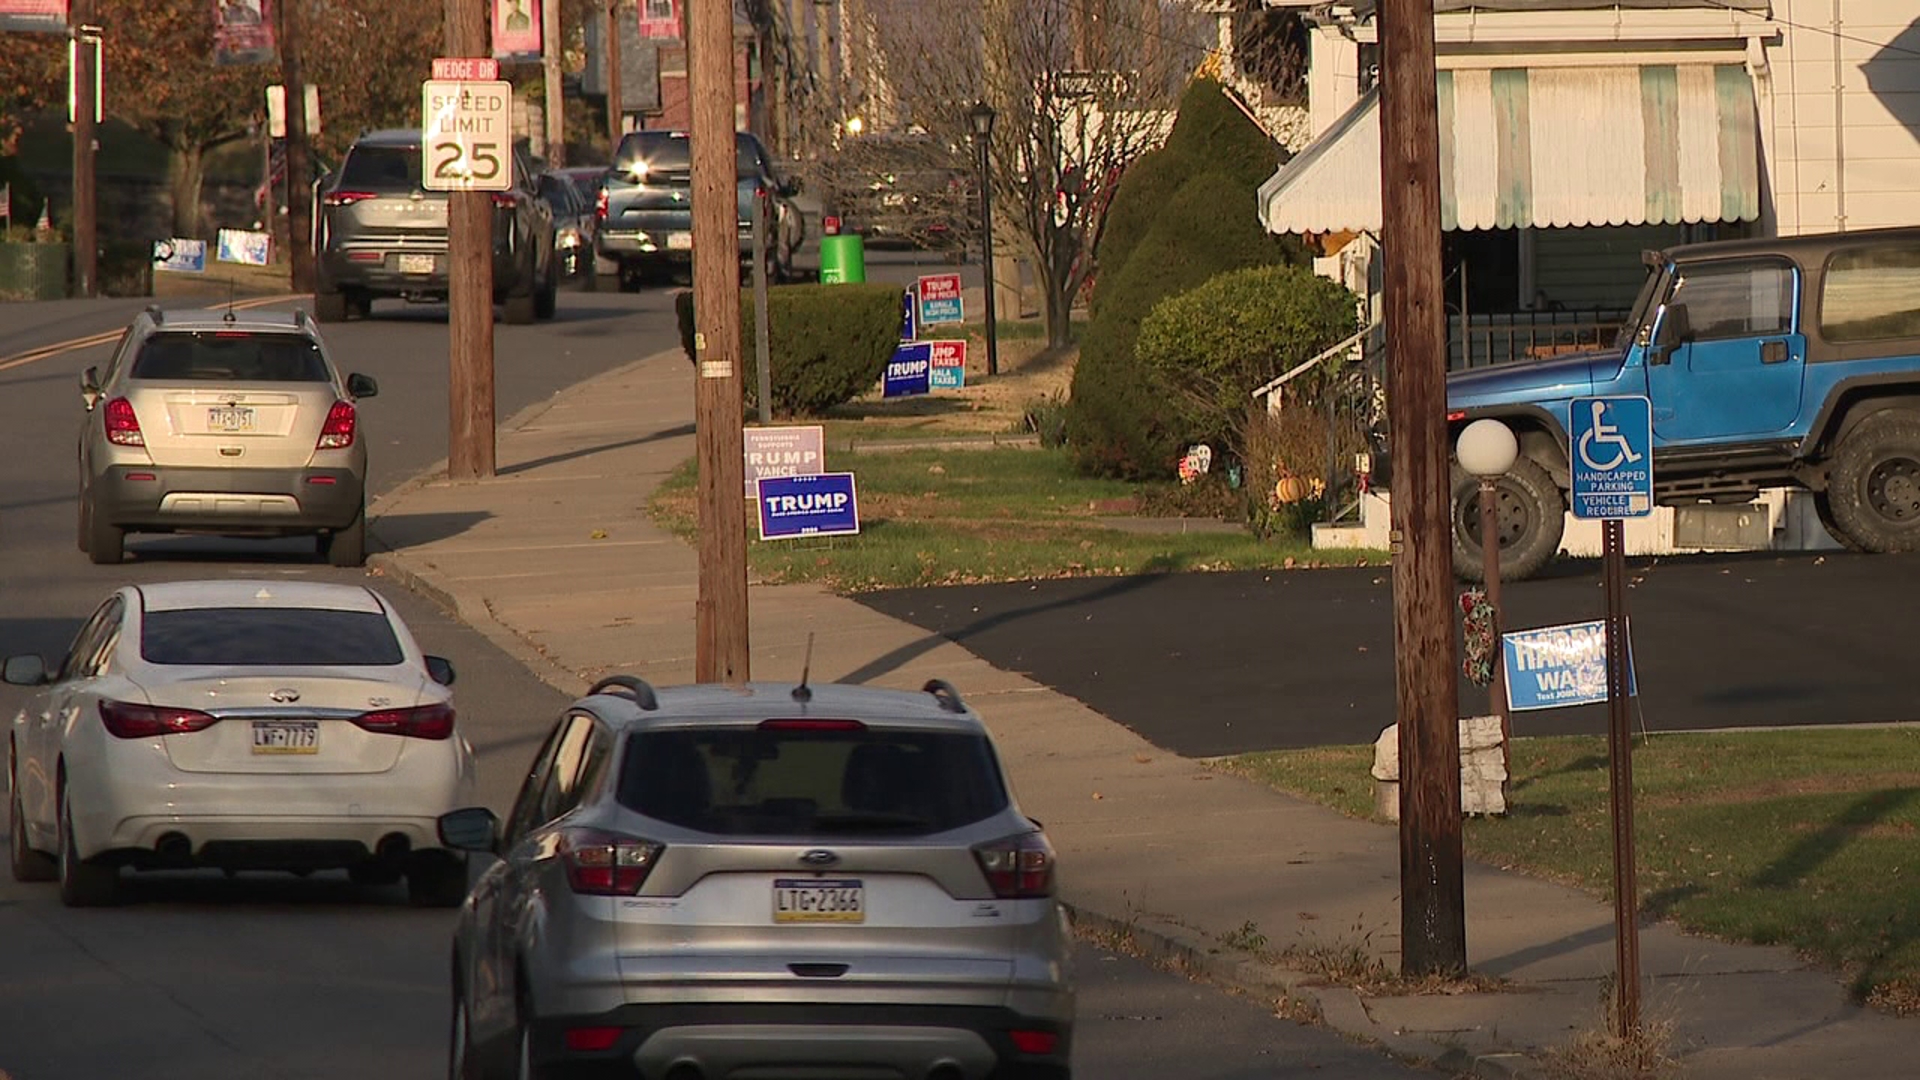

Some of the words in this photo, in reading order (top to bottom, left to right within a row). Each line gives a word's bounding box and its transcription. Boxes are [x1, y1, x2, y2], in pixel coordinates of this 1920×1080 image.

[433, 61, 473, 79] WEDGE
[479, 62, 496, 79] DR
[432, 96, 502, 111] SPEED
[440, 118, 494, 133] LIMIT
[434, 142, 500, 179] 25
[888, 361, 927, 376] TRUMP
[745, 451, 817, 465] RUMP
[1577, 471, 1646, 482] HANDICAPPED
[1591, 482, 1634, 492] PARKING
[766, 493, 848, 512] TRUMP
[1583, 496, 1625, 506] VEHICLE
